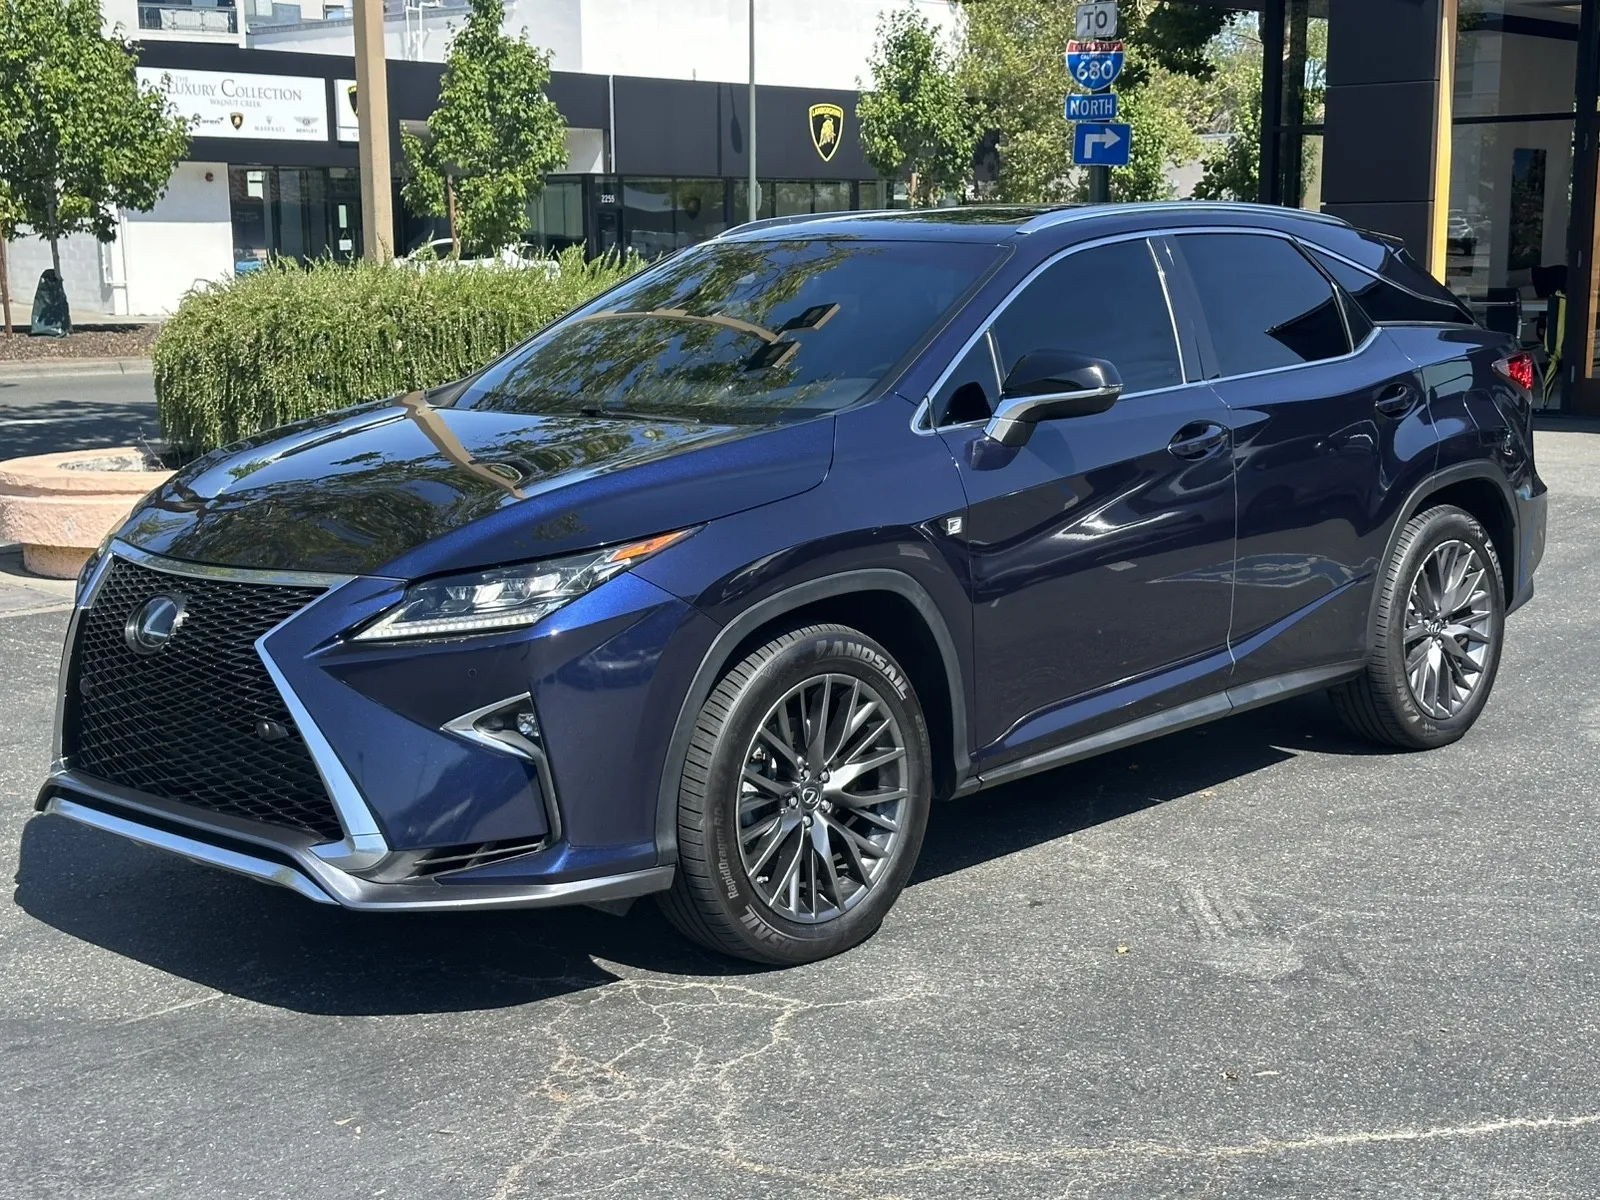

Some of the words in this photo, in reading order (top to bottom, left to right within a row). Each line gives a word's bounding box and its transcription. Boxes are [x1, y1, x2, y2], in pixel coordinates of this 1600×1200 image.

[1083, 10, 1108, 30] TO
[1076, 60, 1114, 80] 680
[1070, 98, 1113, 116] NORTH
[601, 194, 615, 203] 2255
[814, 639, 909, 701] LANDSAIL
